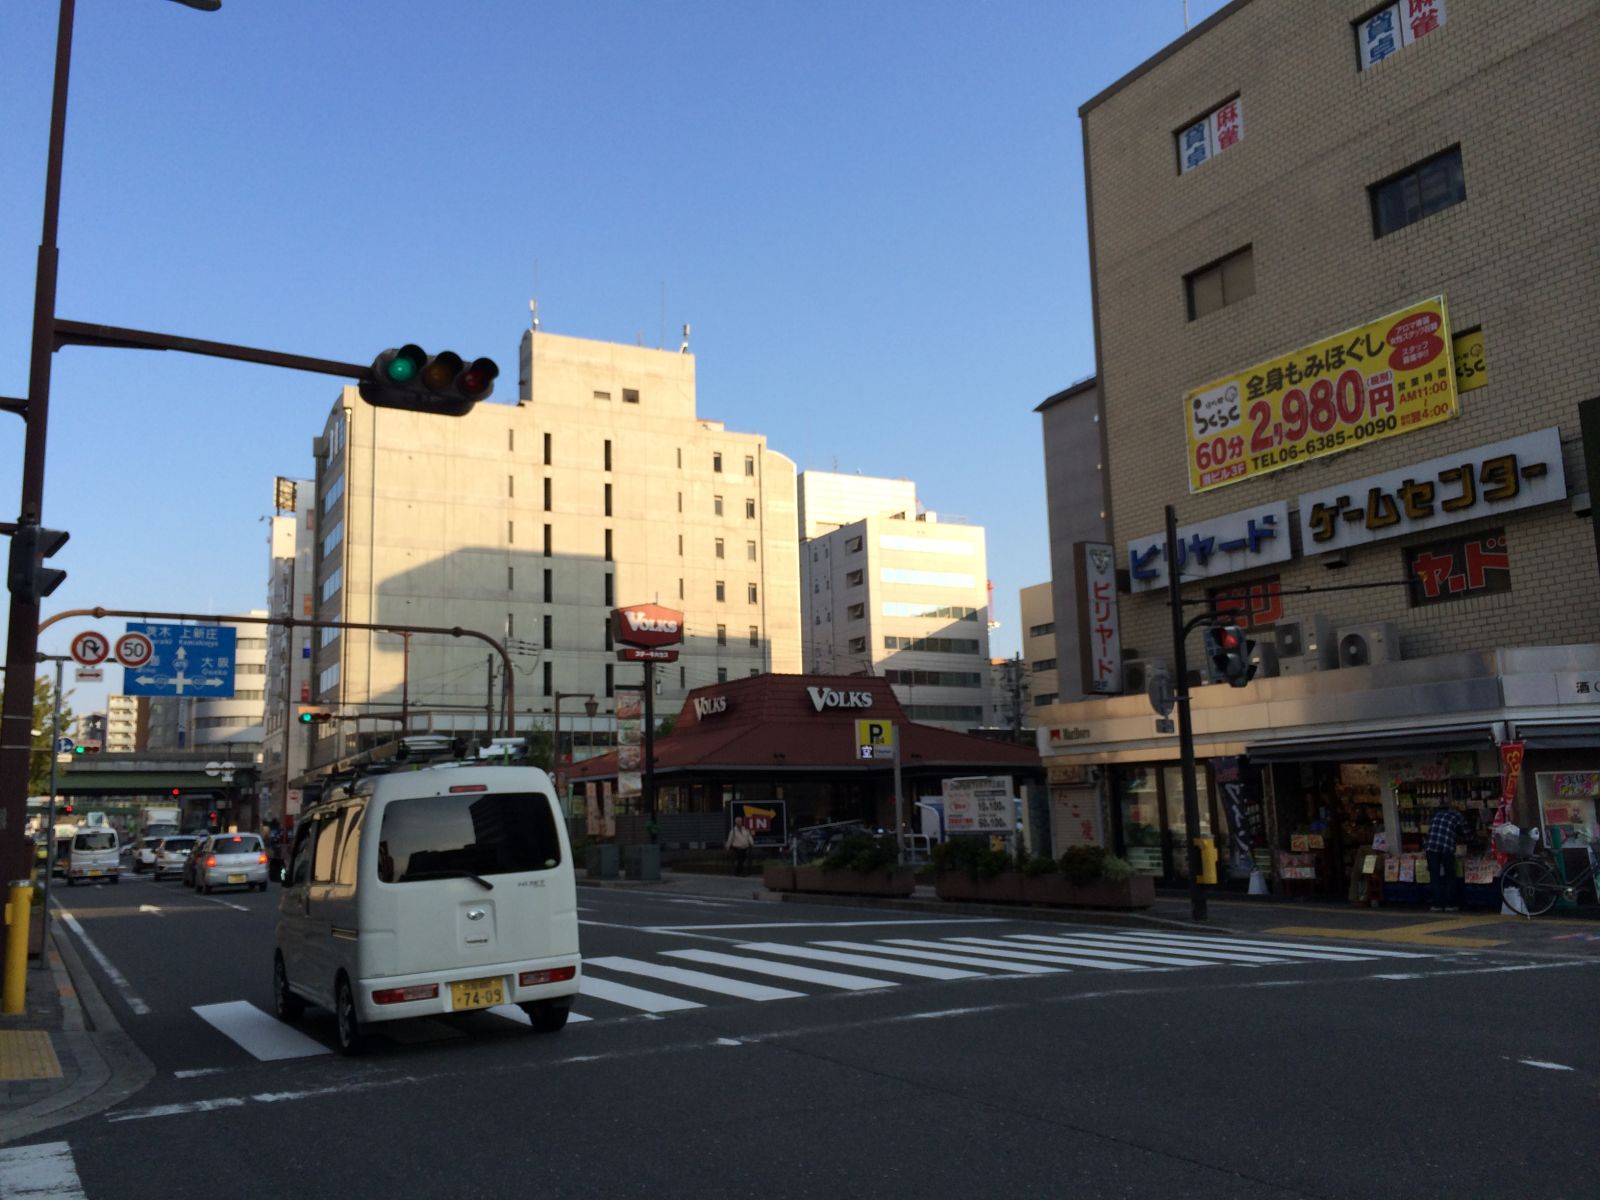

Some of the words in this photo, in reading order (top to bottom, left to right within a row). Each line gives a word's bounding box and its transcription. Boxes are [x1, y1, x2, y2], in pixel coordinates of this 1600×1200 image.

[1246, 333, 1385, 401] 全身もみほぐし
[1399, 380, 1448, 405] AM11:00
[1196, 435, 1244, 470] 60分
[1309, 453, 1548, 543] ゲームセンター
[1131, 514, 1277, 579] ビリヤード
[179, 626, 219, 640] 上新庄
[123, 642, 145, 658] 50
[200, 656, 230, 669] 大阪
[869, 724, 883, 745] P
